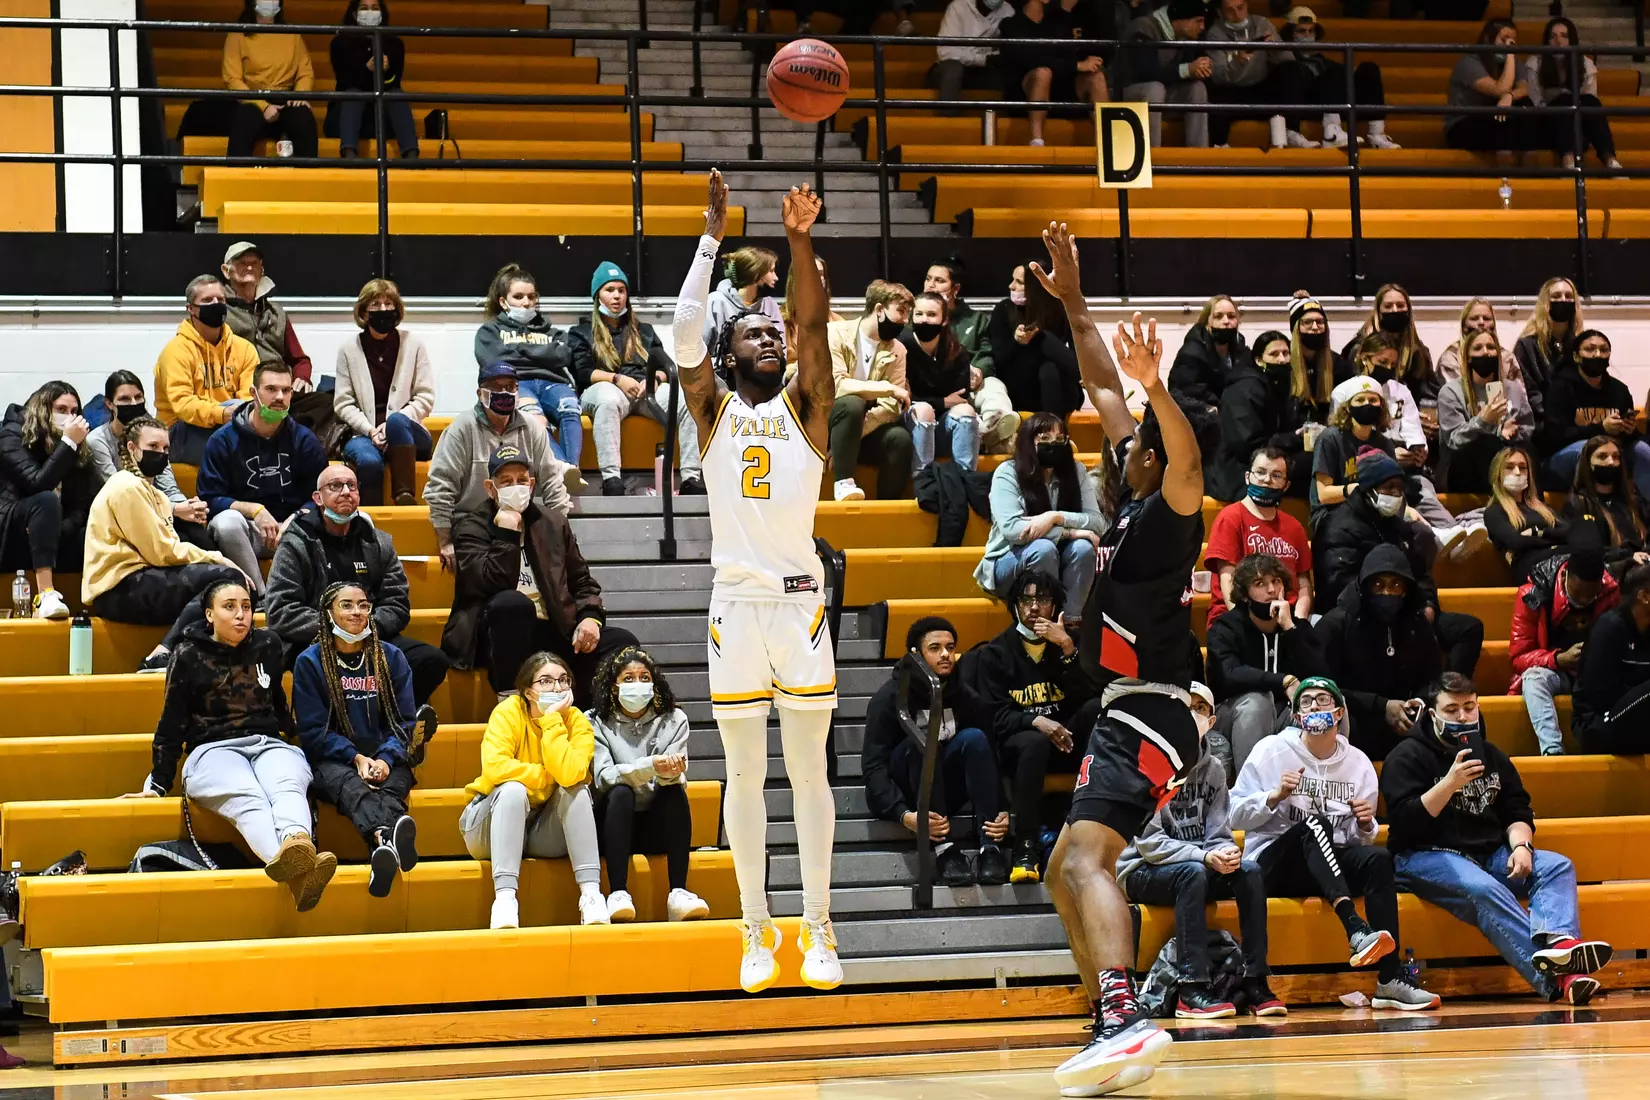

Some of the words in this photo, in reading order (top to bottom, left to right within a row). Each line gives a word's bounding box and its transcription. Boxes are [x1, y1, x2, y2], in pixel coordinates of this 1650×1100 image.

[789, 64, 841, 87] Wilson
[1100, 107, 1145, 183] D
[730, 413, 790, 441] VILLE
[742, 445, 771, 500] 2
